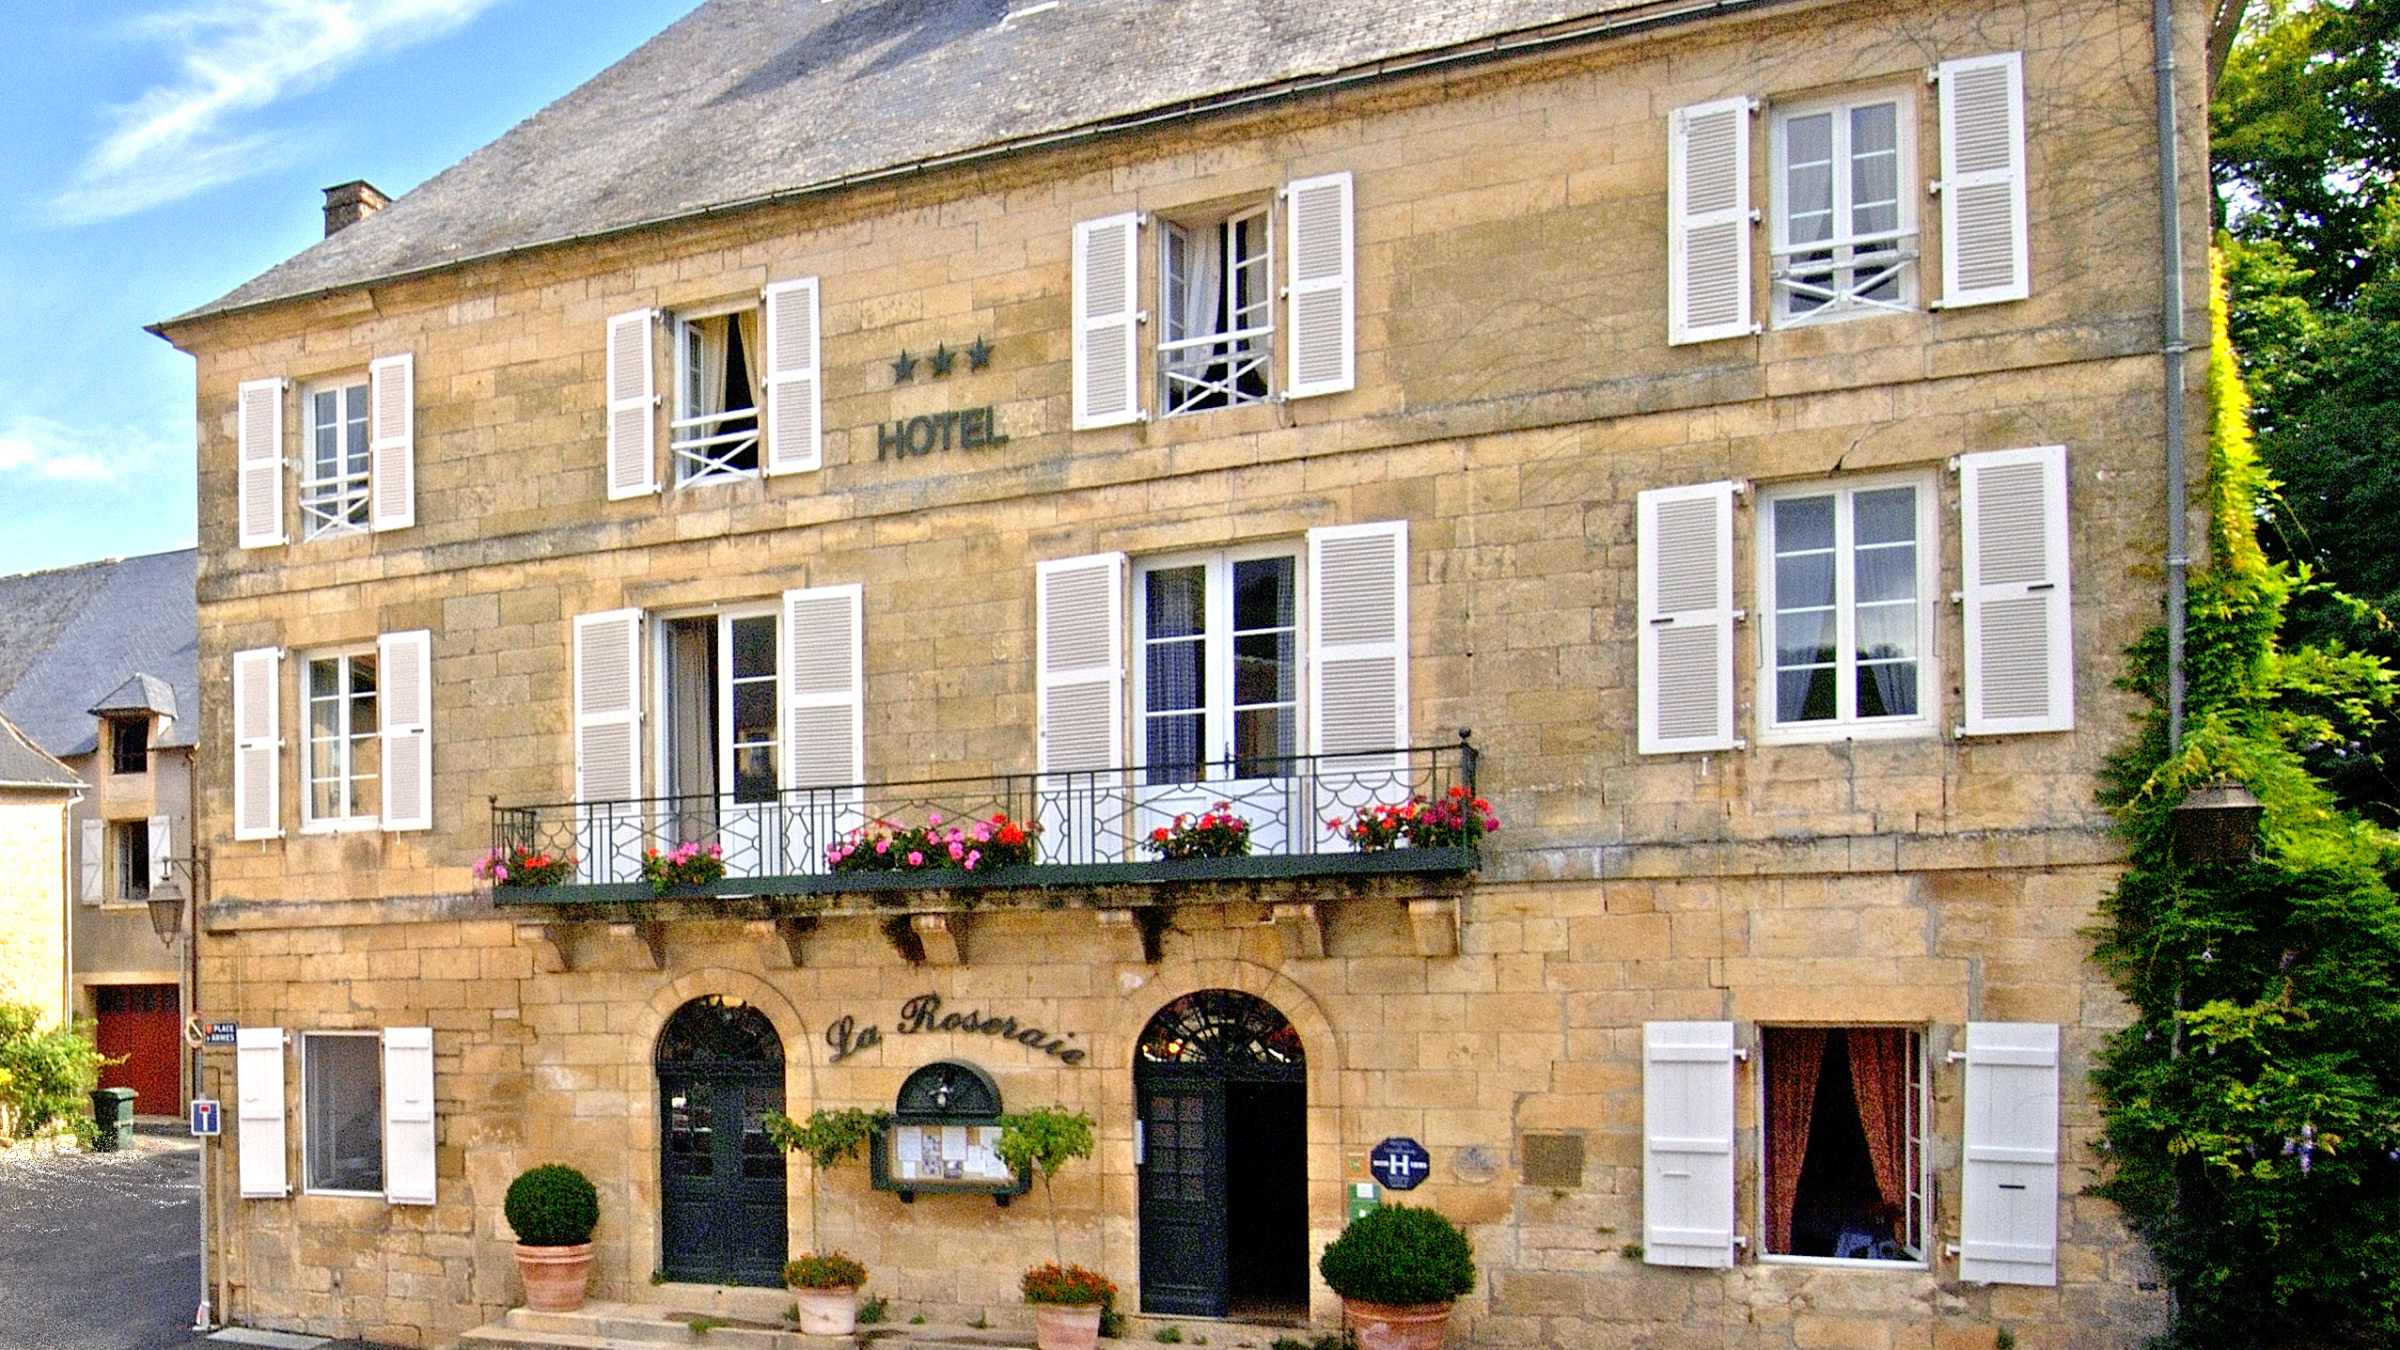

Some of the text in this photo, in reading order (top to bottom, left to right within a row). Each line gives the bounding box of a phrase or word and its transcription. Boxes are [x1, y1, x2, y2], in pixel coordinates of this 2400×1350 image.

[878, 405, 1009, 461] HOTEL
[826, 991, 1085, 1065] La Roseraie
[1390, 1154, 1409, 1175] H
